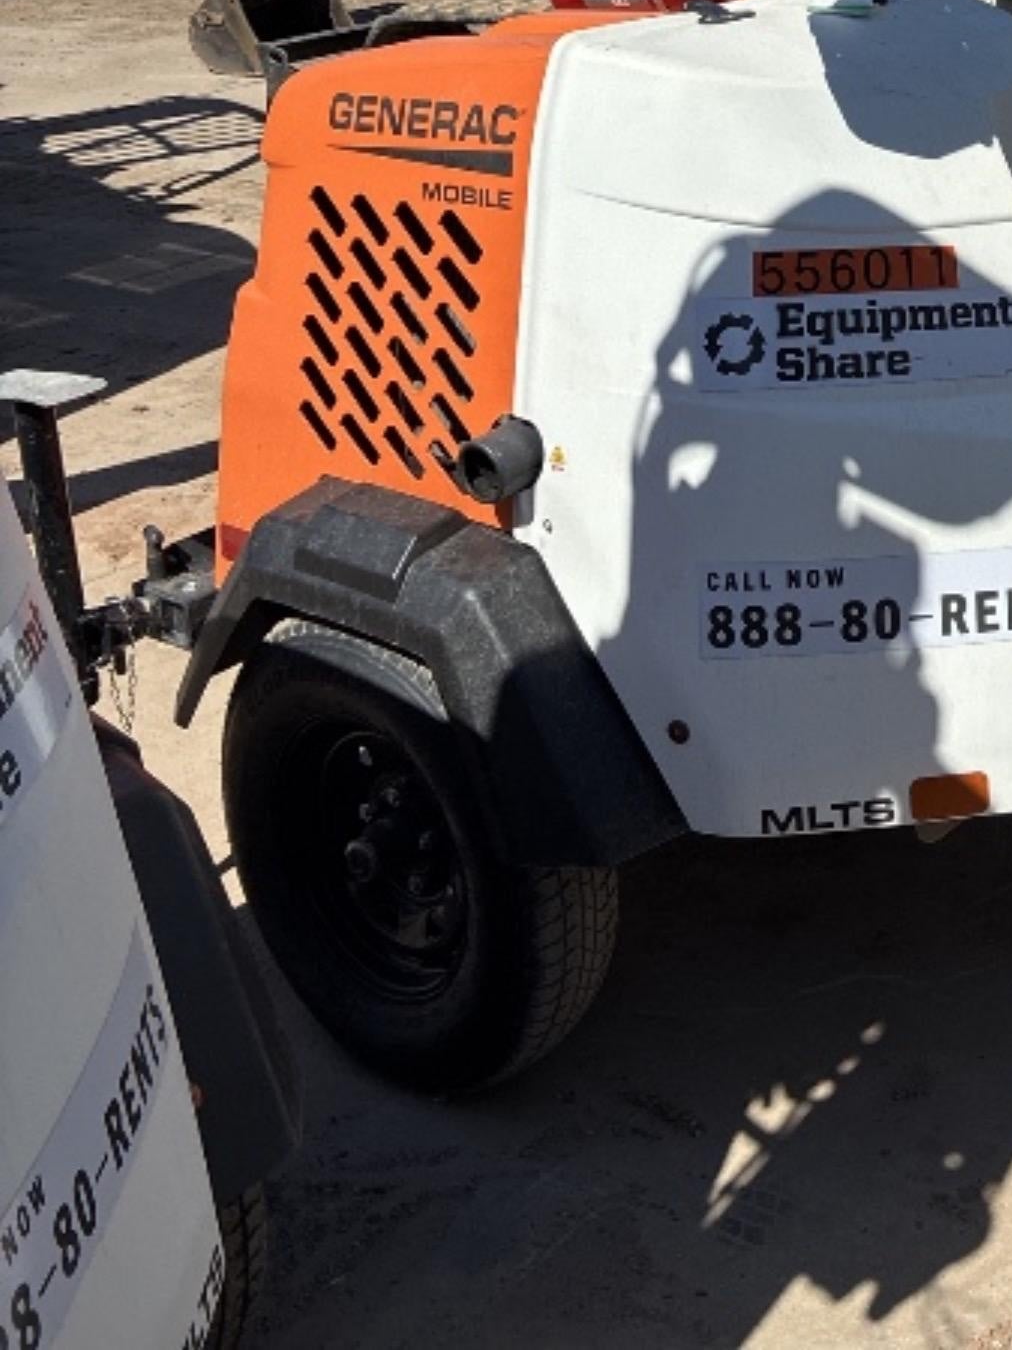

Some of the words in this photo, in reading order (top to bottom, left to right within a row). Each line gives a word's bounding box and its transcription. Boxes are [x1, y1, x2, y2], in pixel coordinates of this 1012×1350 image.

[329, 92, 517, 144] GENERAC
[422, 182, 513, 210] MOBILE
[760, 249, 948, 294] 556011
[776, 347, 911, 381] Share
[706, 570, 771, 592] CALL
[786, 567, 844, 591] NOW
[761, 798, 895, 834] MLTS
[0, 1174, 46, 1266] NOW
